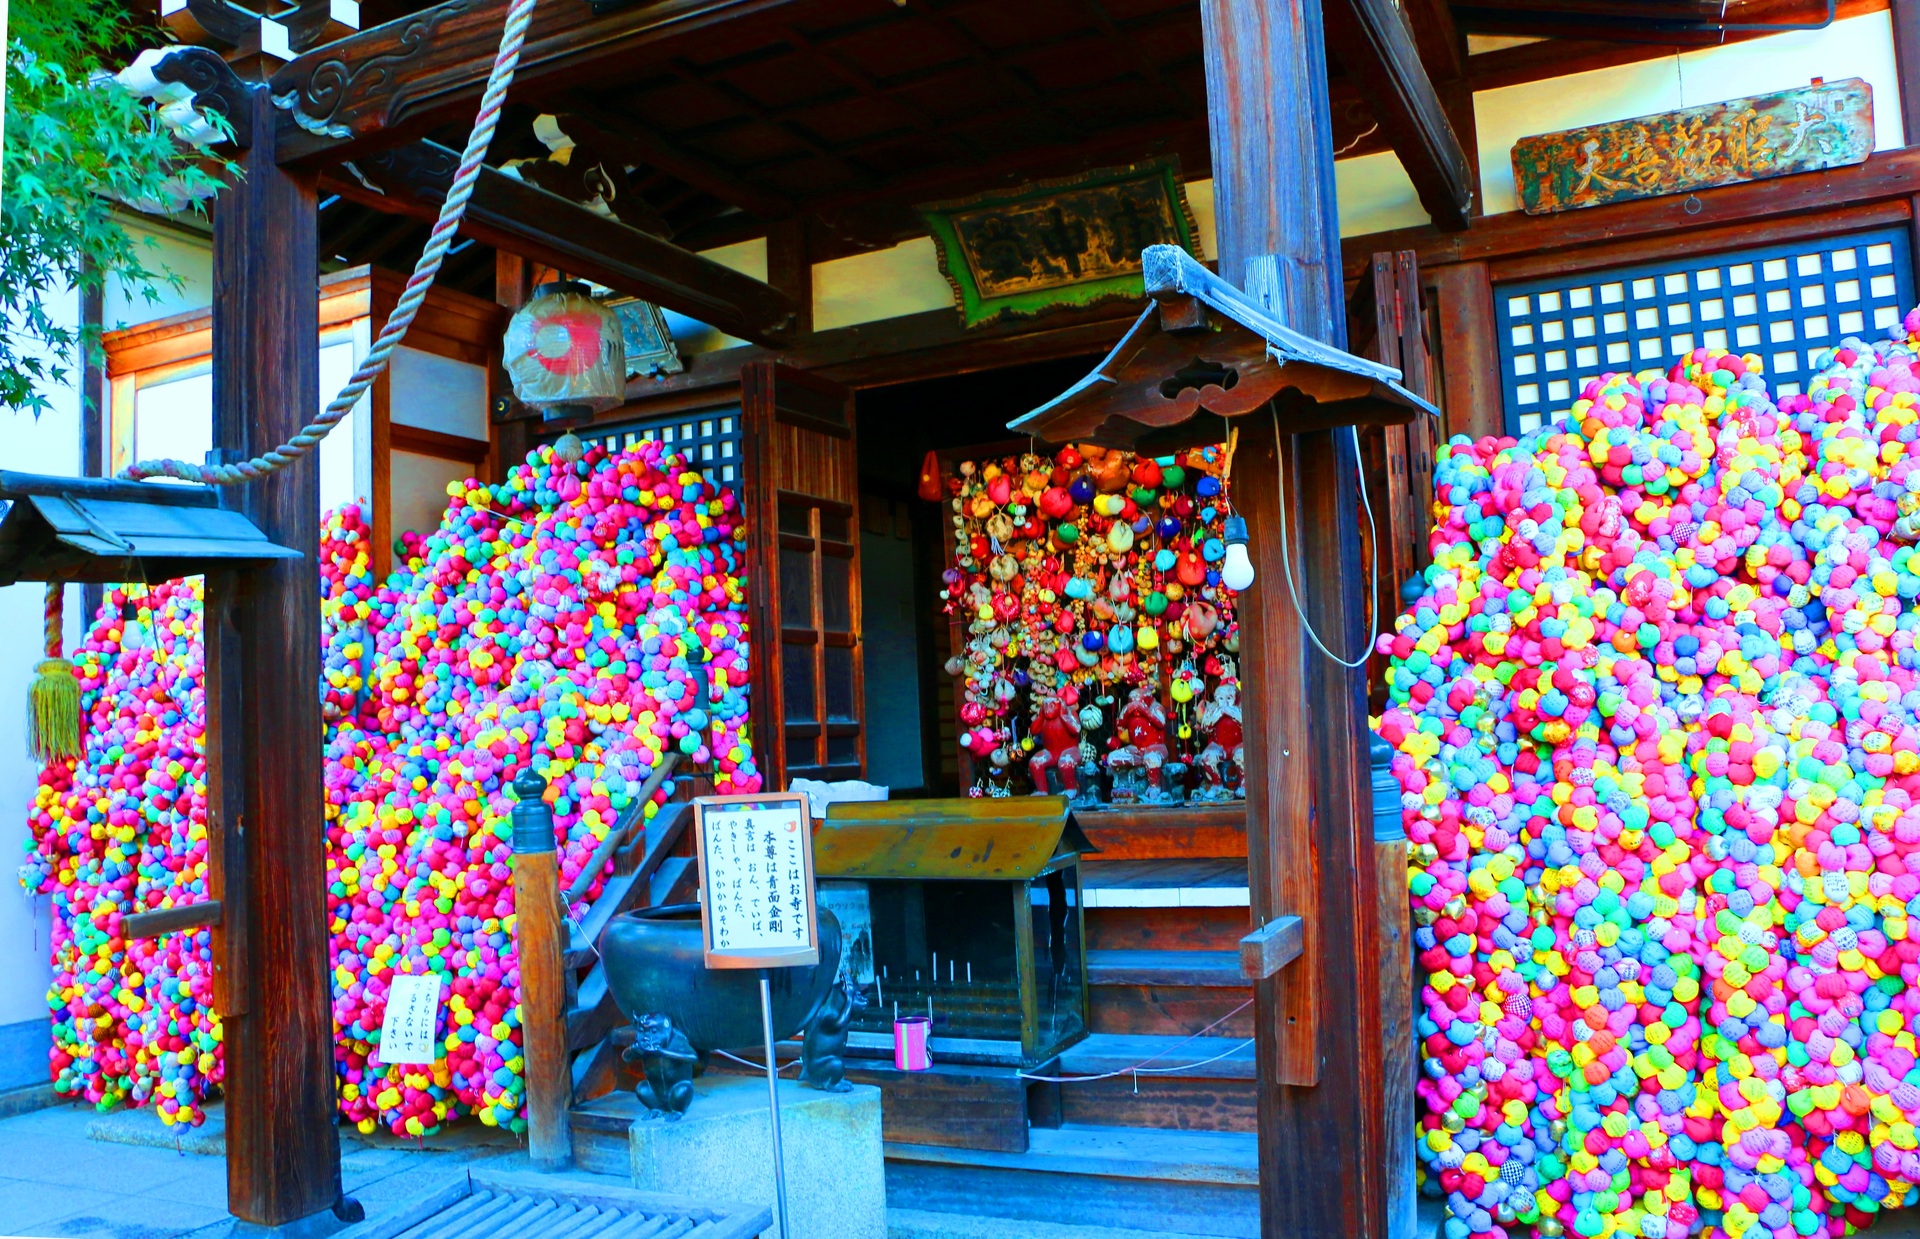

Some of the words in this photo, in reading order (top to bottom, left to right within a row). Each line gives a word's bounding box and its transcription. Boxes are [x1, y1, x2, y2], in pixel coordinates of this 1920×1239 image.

[763, 830, 783, 934] 本尊は青面金剛
[788, 838, 804, 941] ここはお寺です
[389, 1016, 400, 1050] 下さい
[420, 981, 433, 1040] こちらには
